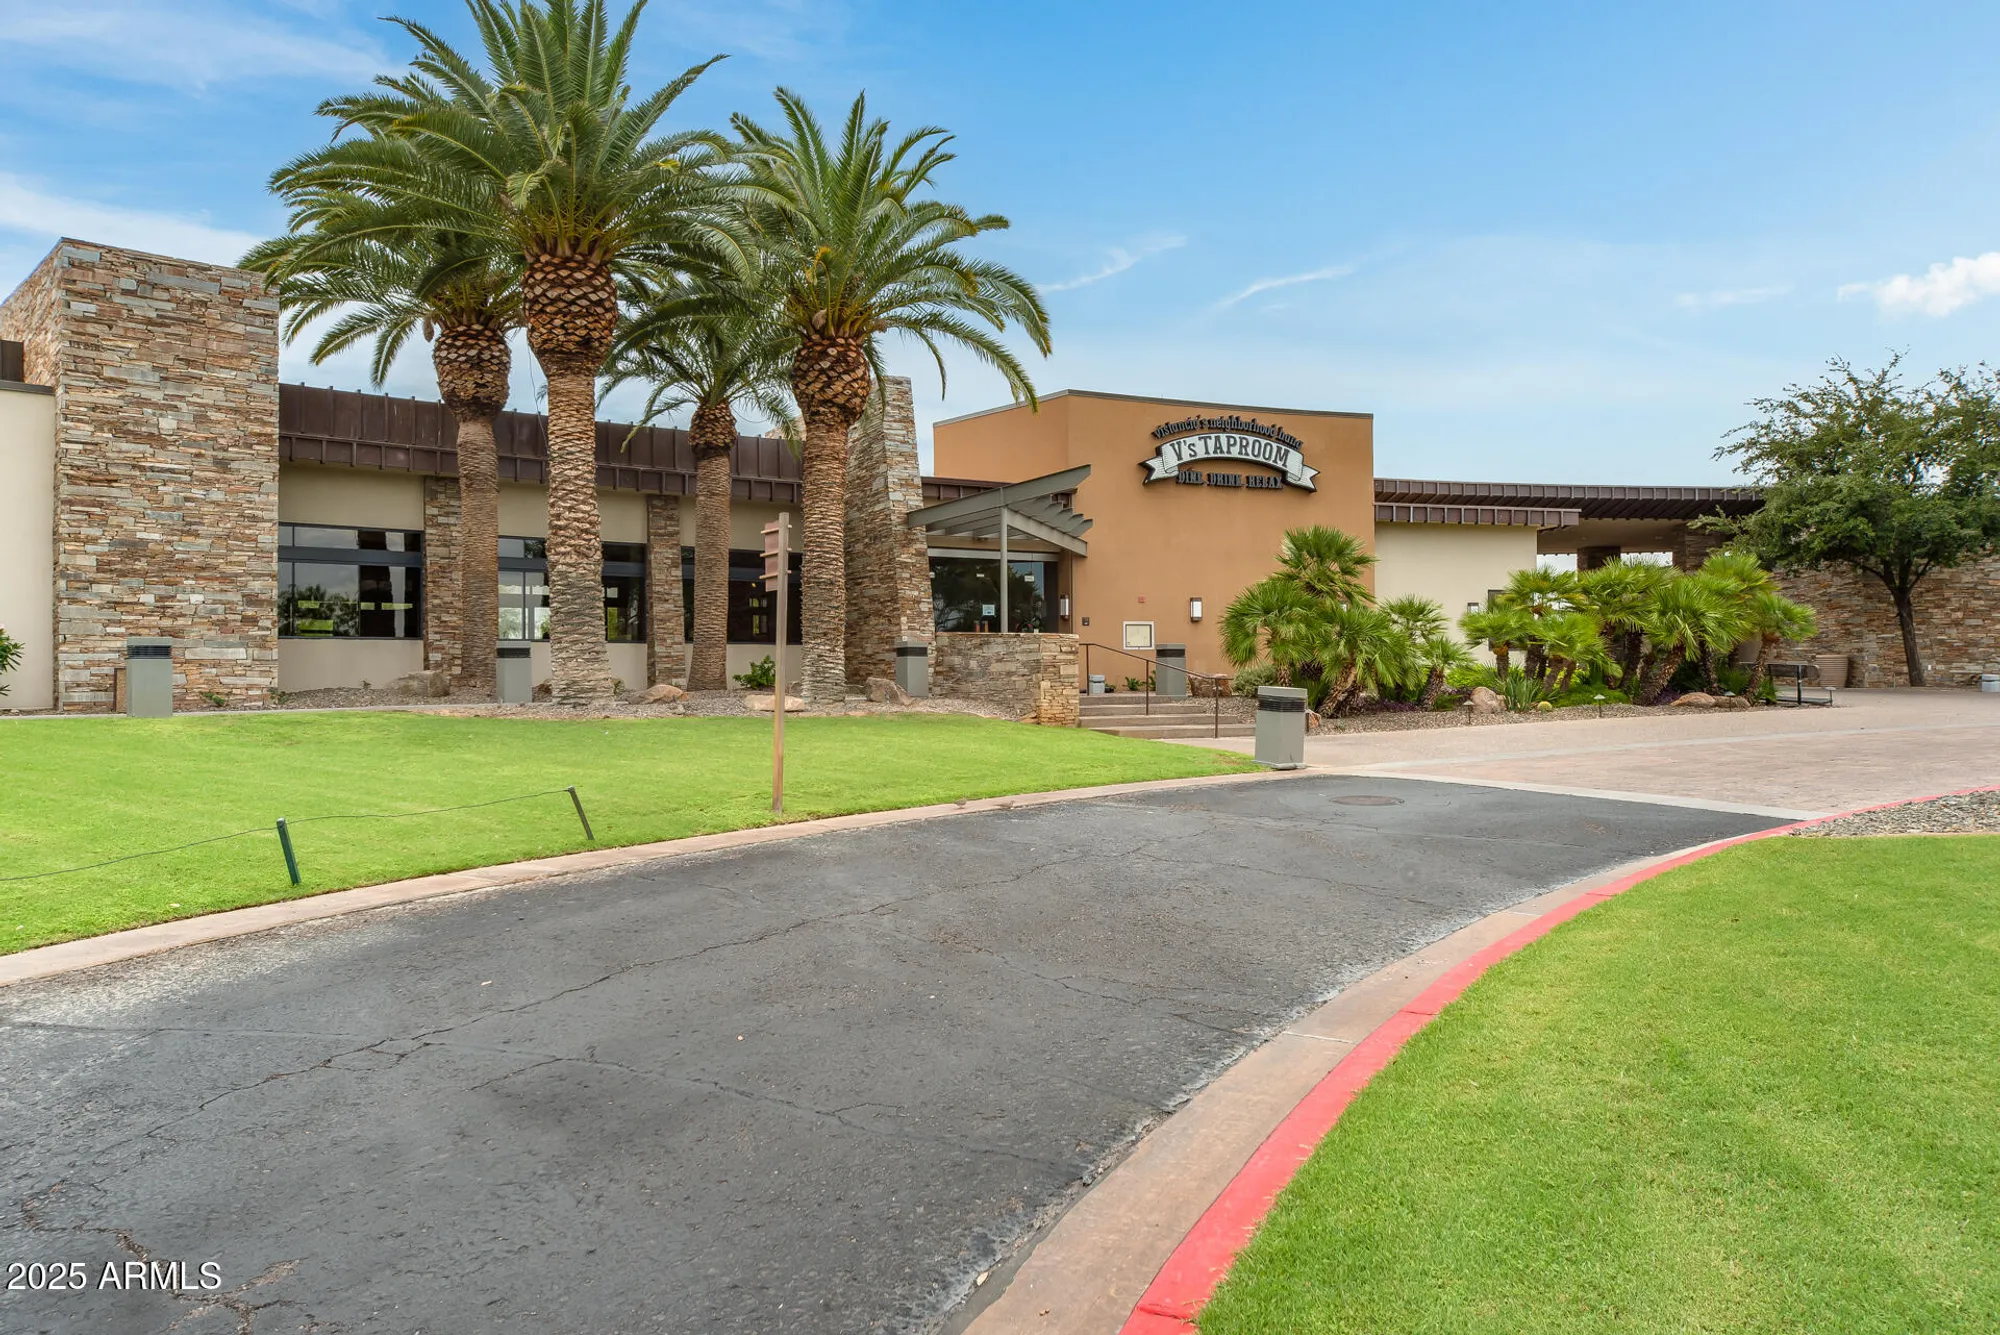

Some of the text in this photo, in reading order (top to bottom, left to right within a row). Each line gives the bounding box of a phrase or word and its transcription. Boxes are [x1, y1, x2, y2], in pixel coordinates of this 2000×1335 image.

[1208, 415, 1276, 437] neighborhood
[1170, 435, 1290, 467] V's TAPROOM
